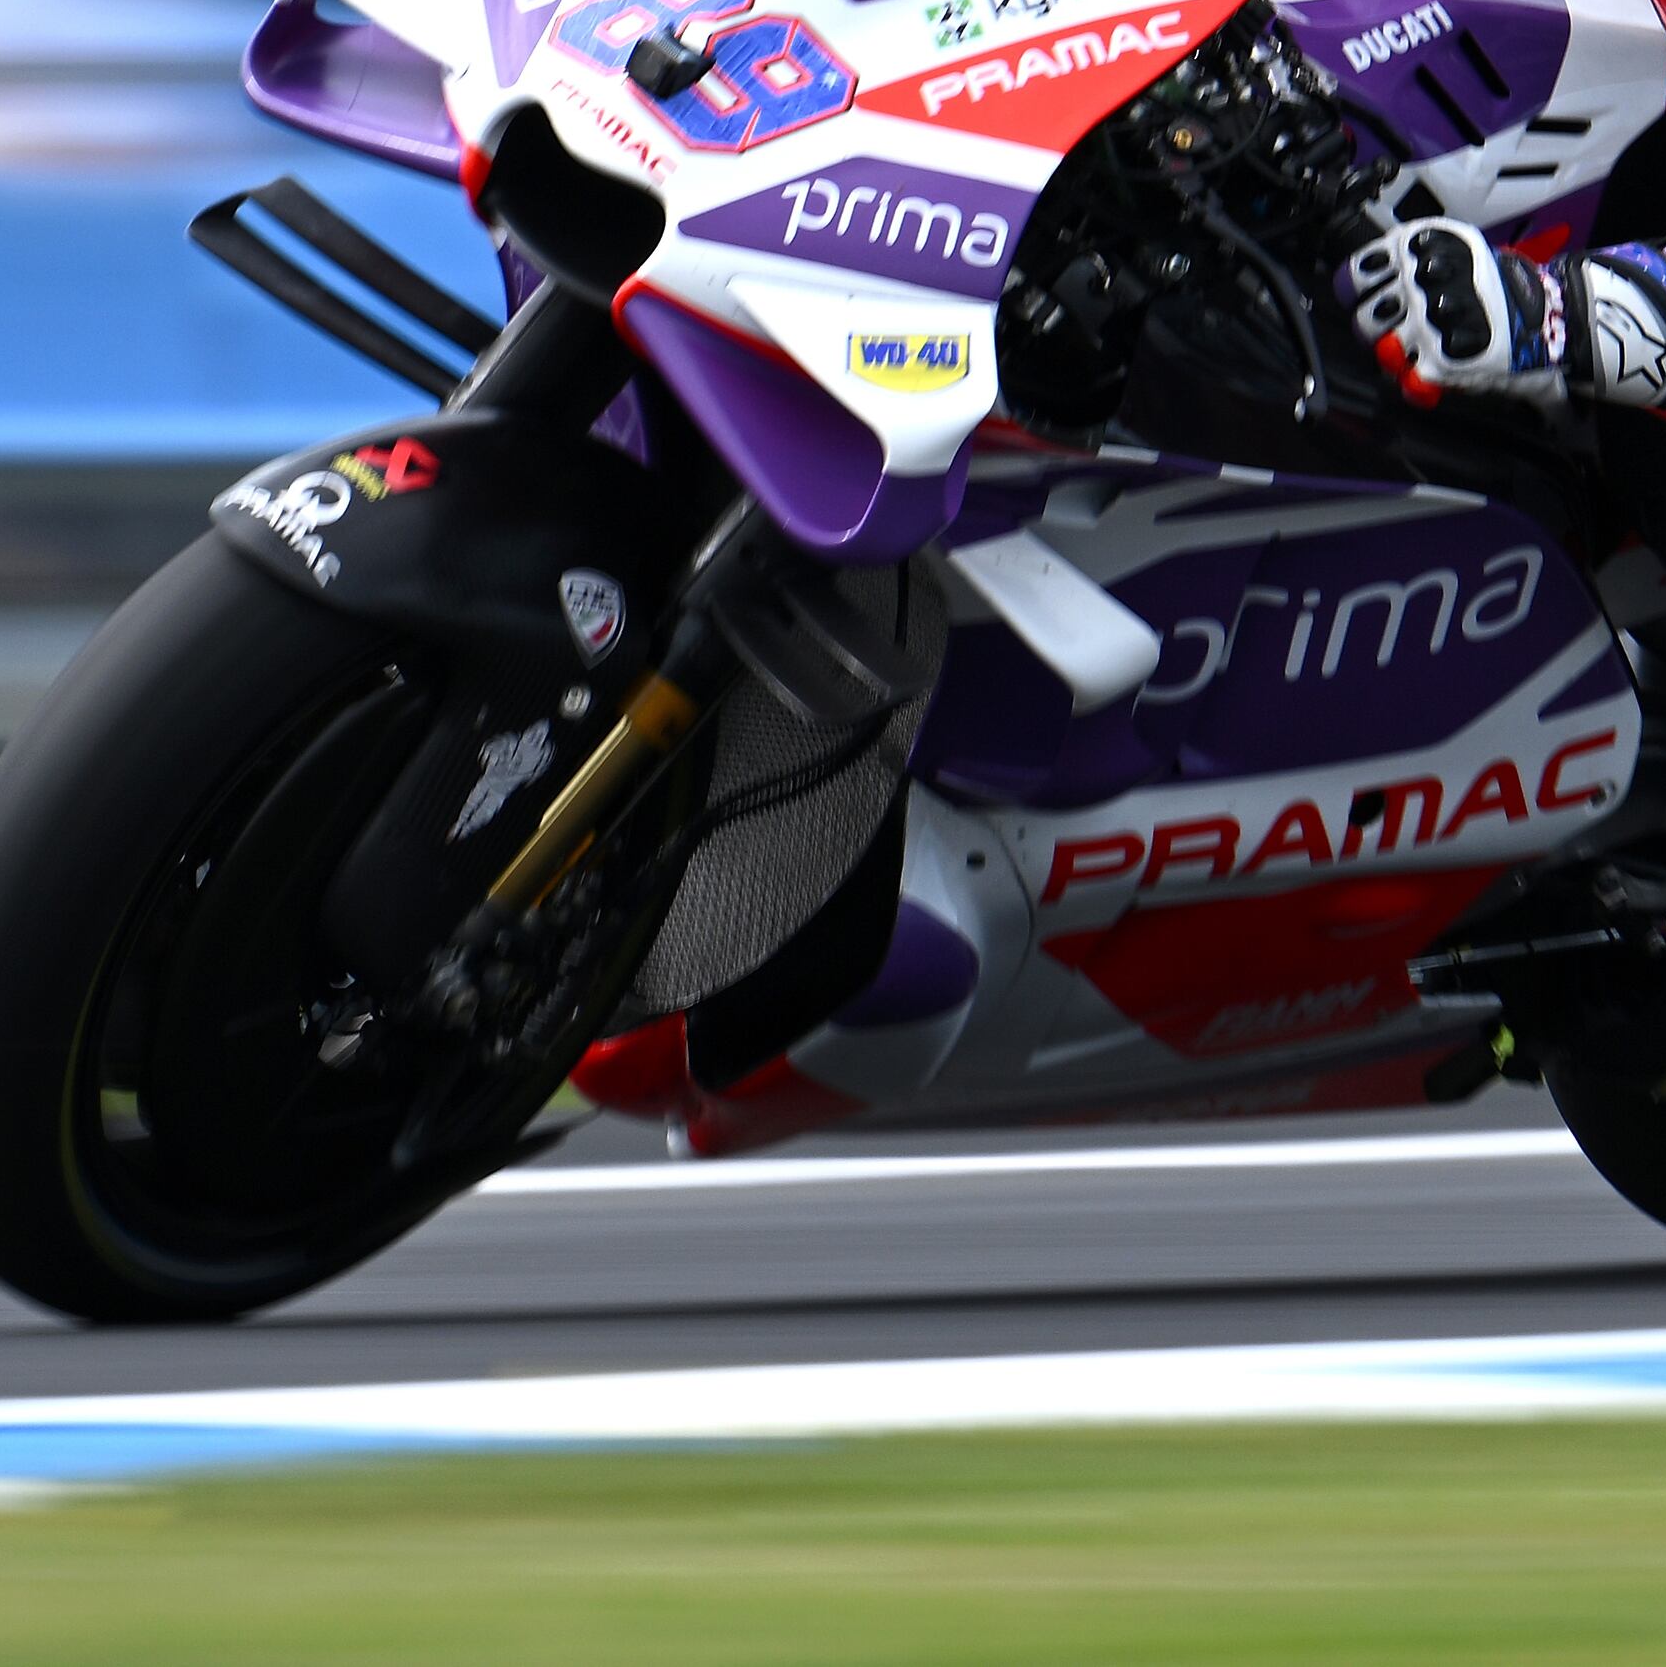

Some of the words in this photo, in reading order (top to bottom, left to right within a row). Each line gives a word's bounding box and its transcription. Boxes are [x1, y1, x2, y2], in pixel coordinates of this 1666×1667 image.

[920, 10, 1190, 117] PRAMAC
[1342, 0, 1454, 74] DUCATI
[780, 177, 1010, 268] prima
[1039, 728, 1617, 907] PRAMAC
